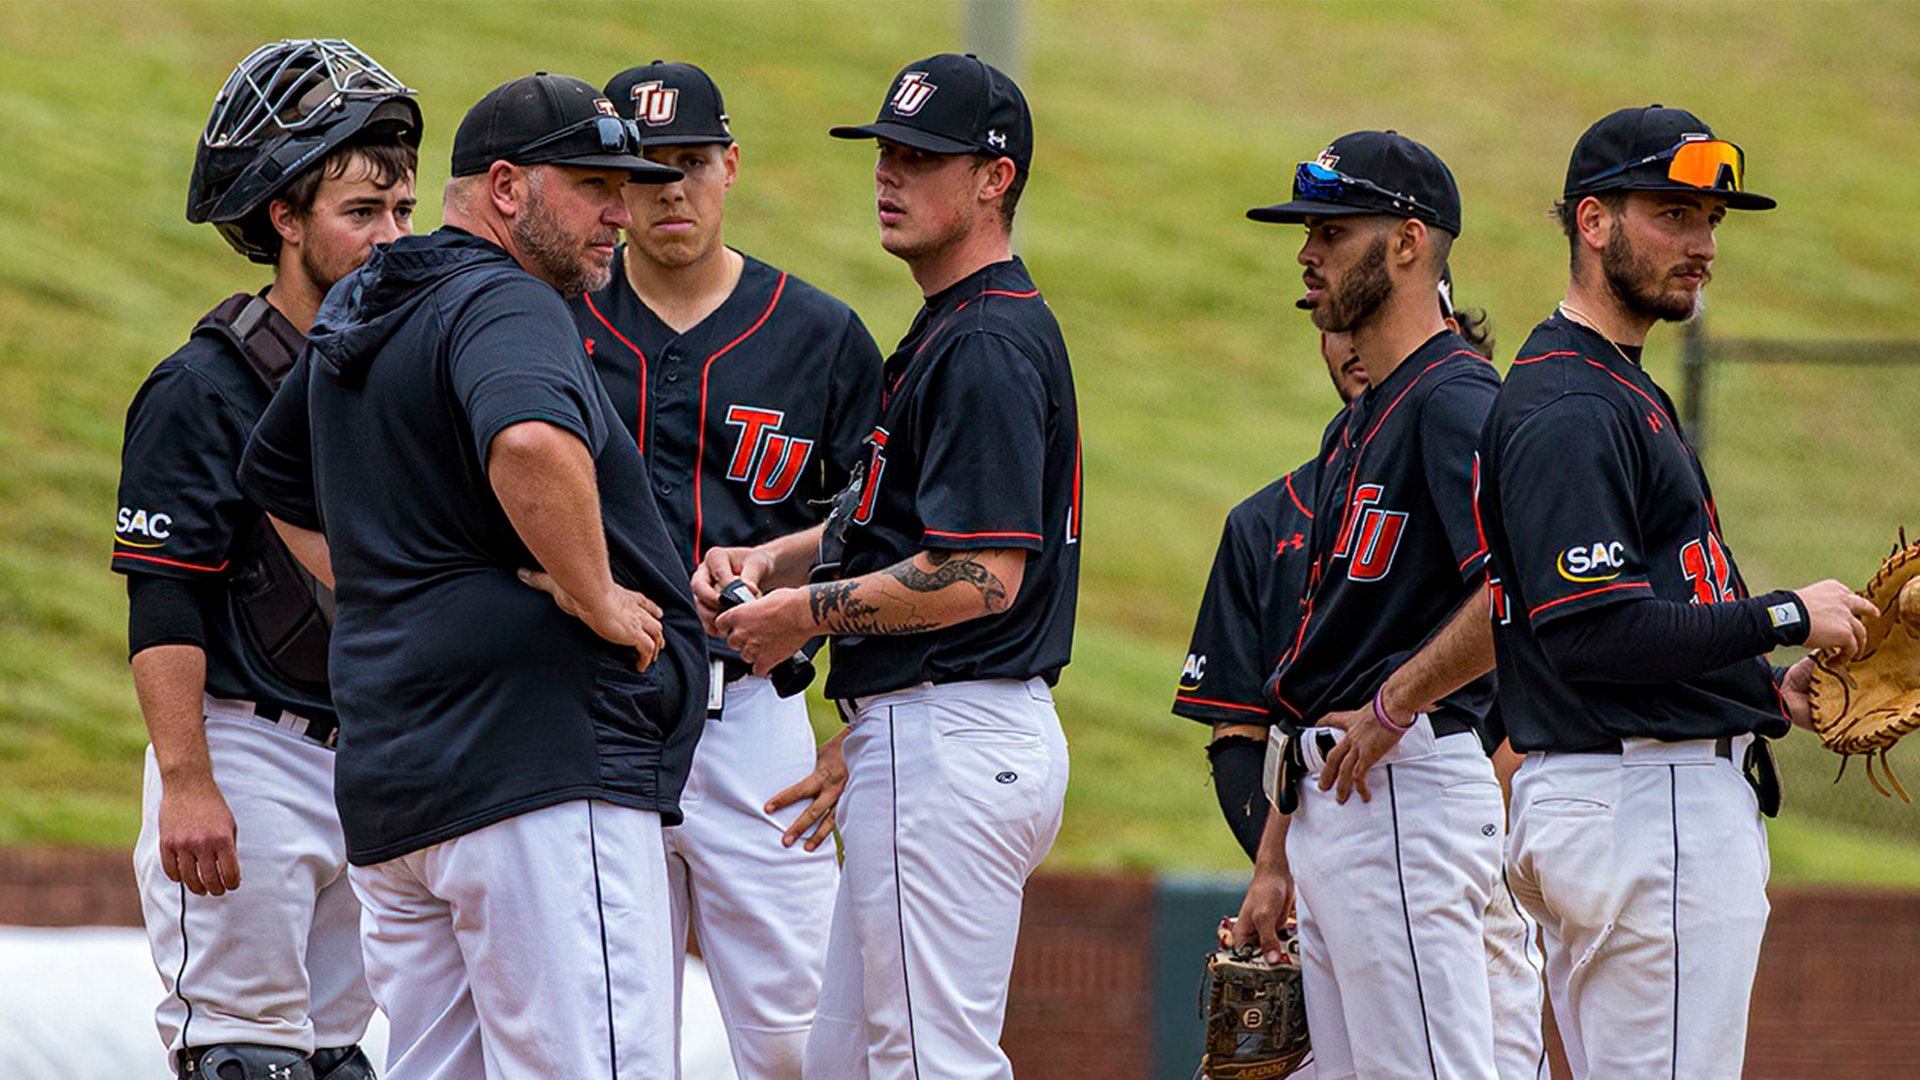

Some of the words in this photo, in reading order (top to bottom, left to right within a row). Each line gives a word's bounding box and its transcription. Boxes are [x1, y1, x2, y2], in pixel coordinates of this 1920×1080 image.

[631, 80, 679, 127] TU
[890, 71, 938, 117] TU
[725, 404, 814, 505] TU
[115, 506, 173, 539] SAC
[1333, 483, 1410, 582] TU
[1567, 541, 1625, 573] SAC
[1180, 653, 1207, 681] AC
